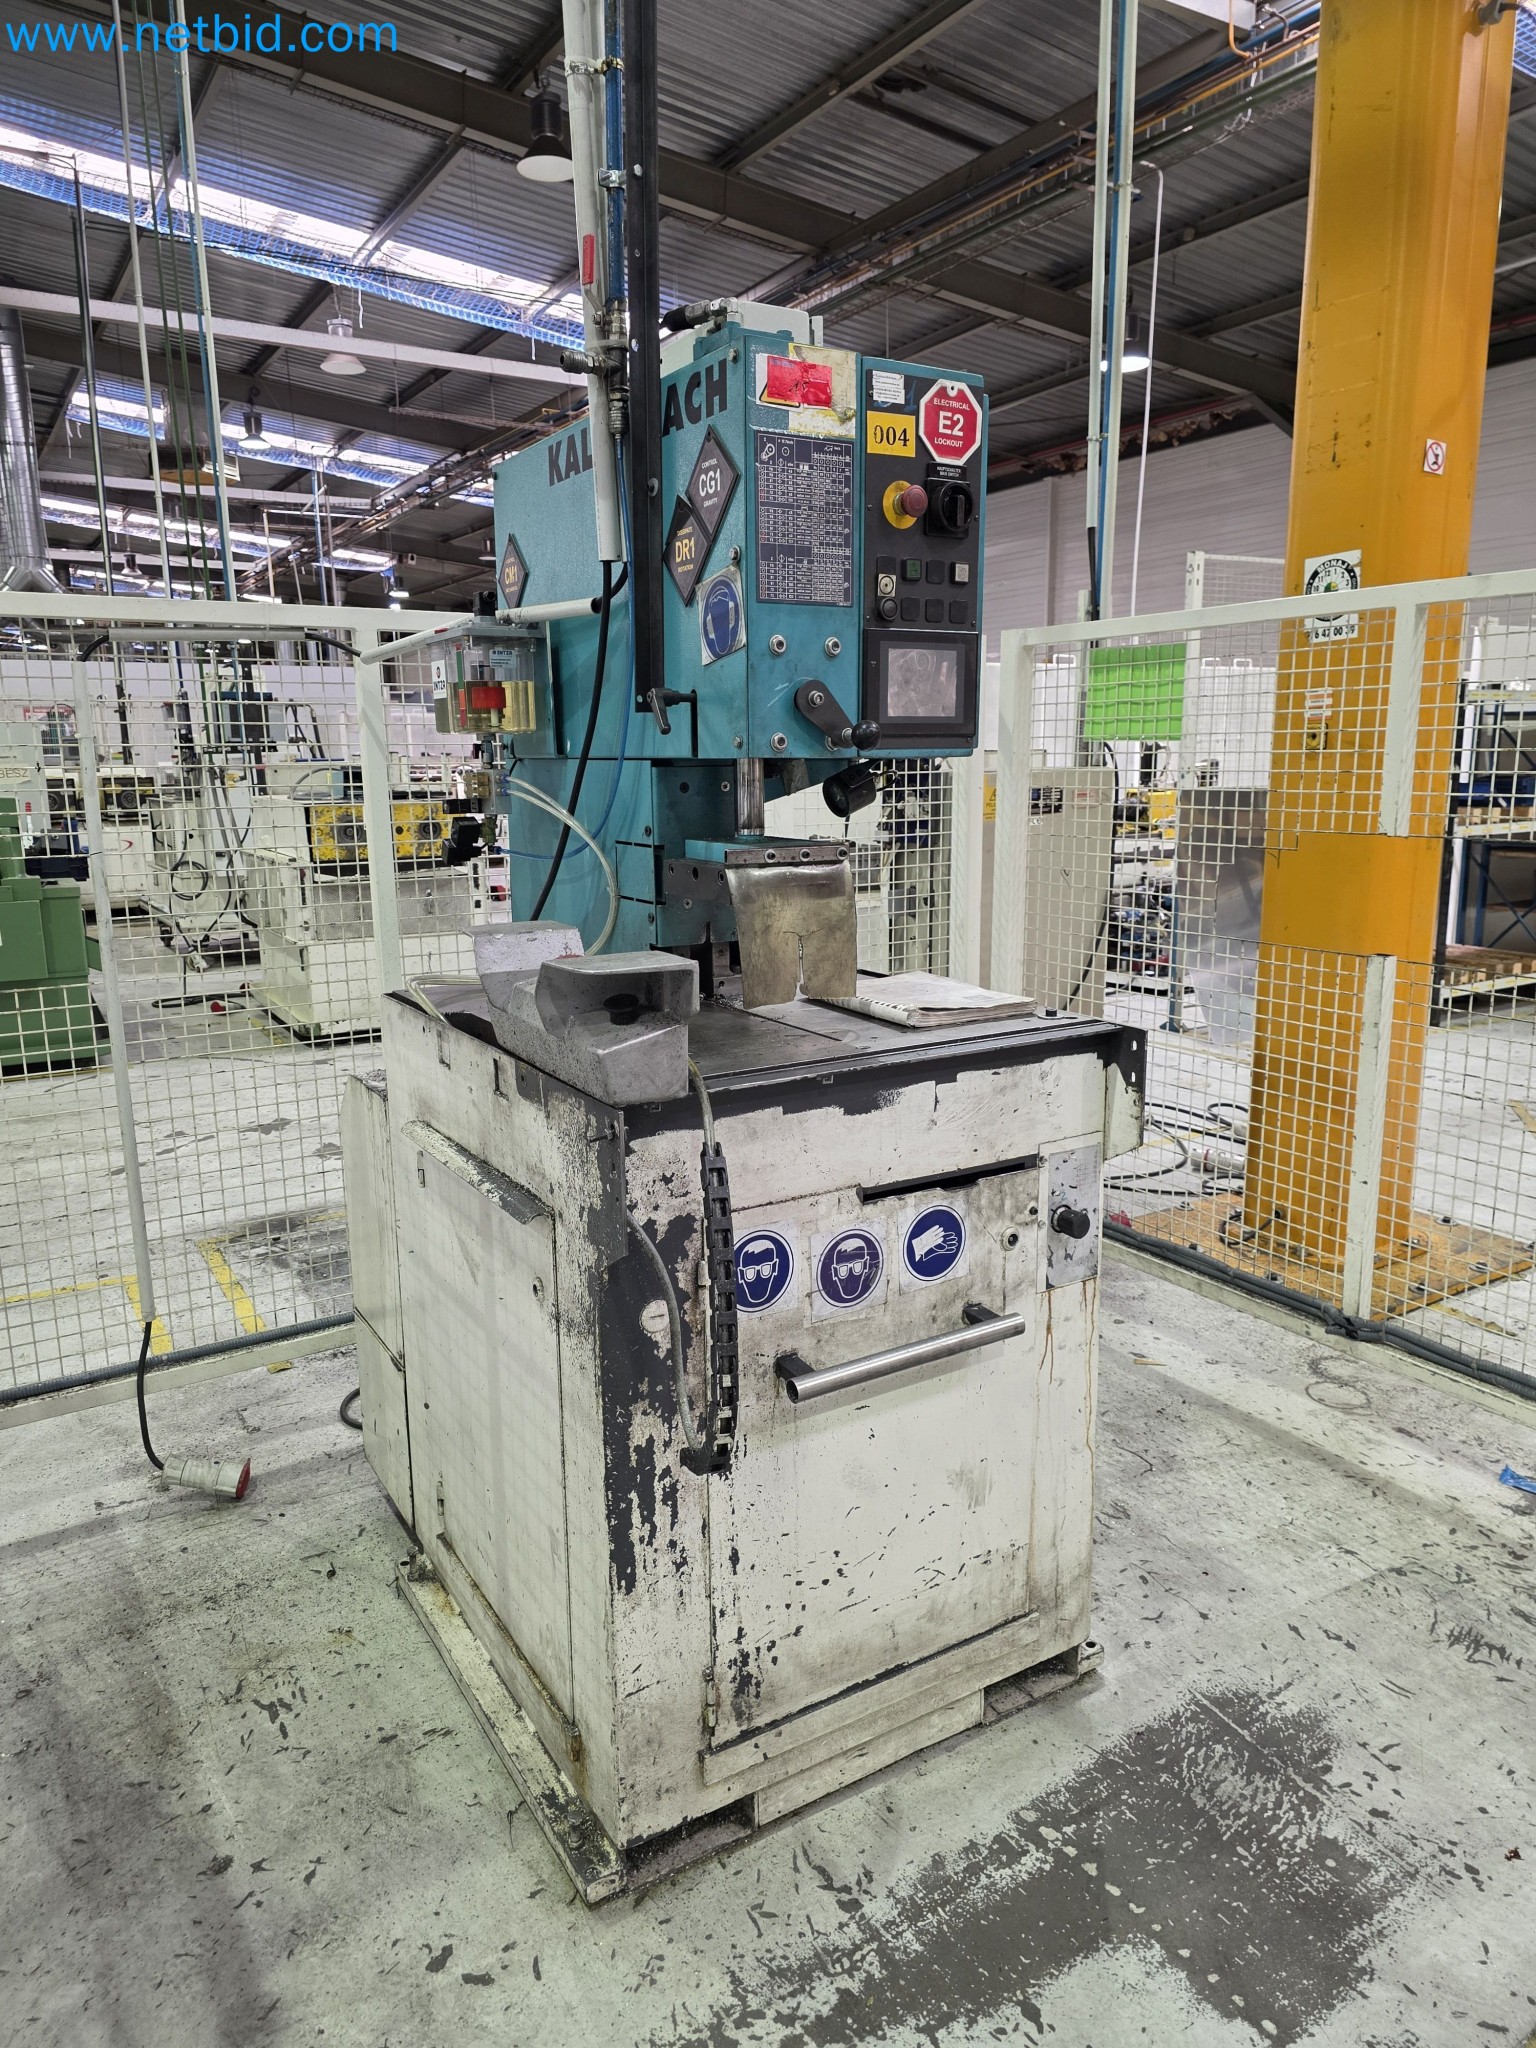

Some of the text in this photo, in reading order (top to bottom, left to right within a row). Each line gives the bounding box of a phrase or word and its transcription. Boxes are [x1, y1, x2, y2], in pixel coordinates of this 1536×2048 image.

[933, 397, 970, 411] ELECTRICAL
[547, 357, 728, 488] KALACH
[938, 410, 965, 437] E2
[874, 425, 910, 447] 004
[934, 437, 964, 448] LOCKOUT
[701, 458, 719, 469] CONTROL
[699, 468, 721, 497] CG1
[703, 497, 718, 508] GRAVITY
[675, 537, 696, 563] DR1
[677, 563, 694, 573] ROTATION
